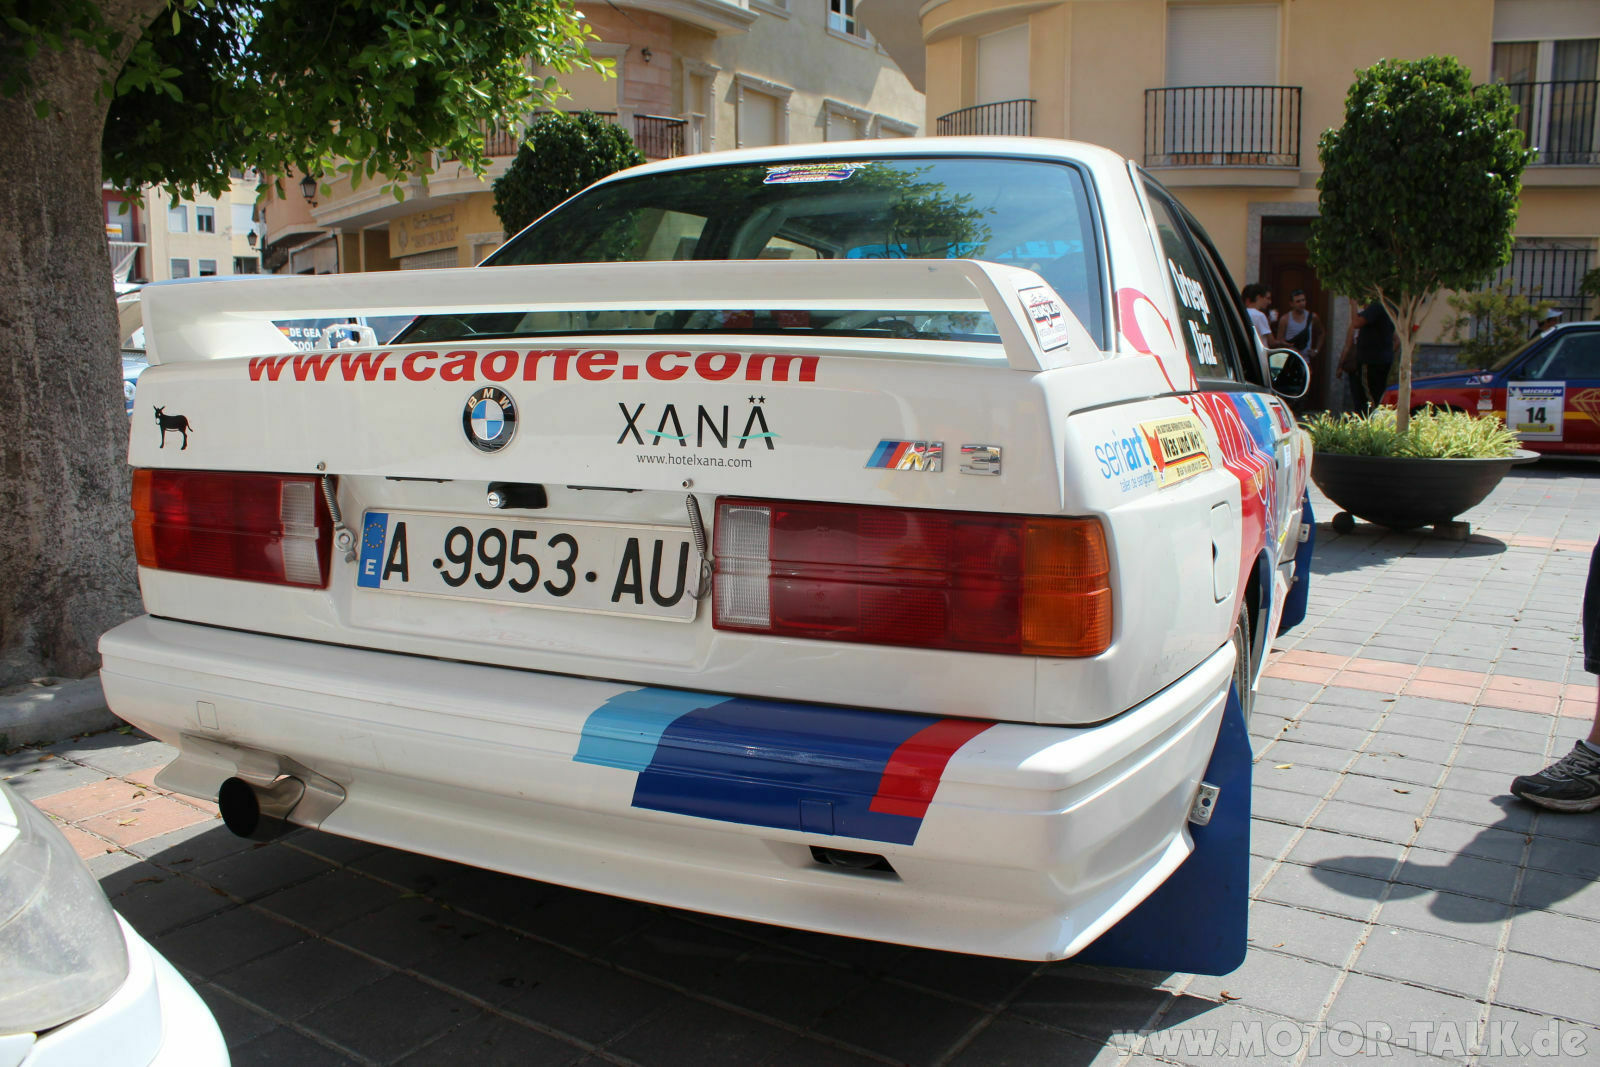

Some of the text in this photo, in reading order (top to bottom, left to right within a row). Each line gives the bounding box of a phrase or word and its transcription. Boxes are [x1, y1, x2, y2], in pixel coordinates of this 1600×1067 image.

[289, 327, 302, 338] DE
[303, 327, 322, 338] GEA
[1526, 406, 1547, 423] 14
[1160, 436, 1179, 458] Was
[636, 453, 753, 468] www.hotelxana.com
[363, 558, 377, 576] E
[382, 521, 409, 582] A
[611, 537, 690, 608] AU
